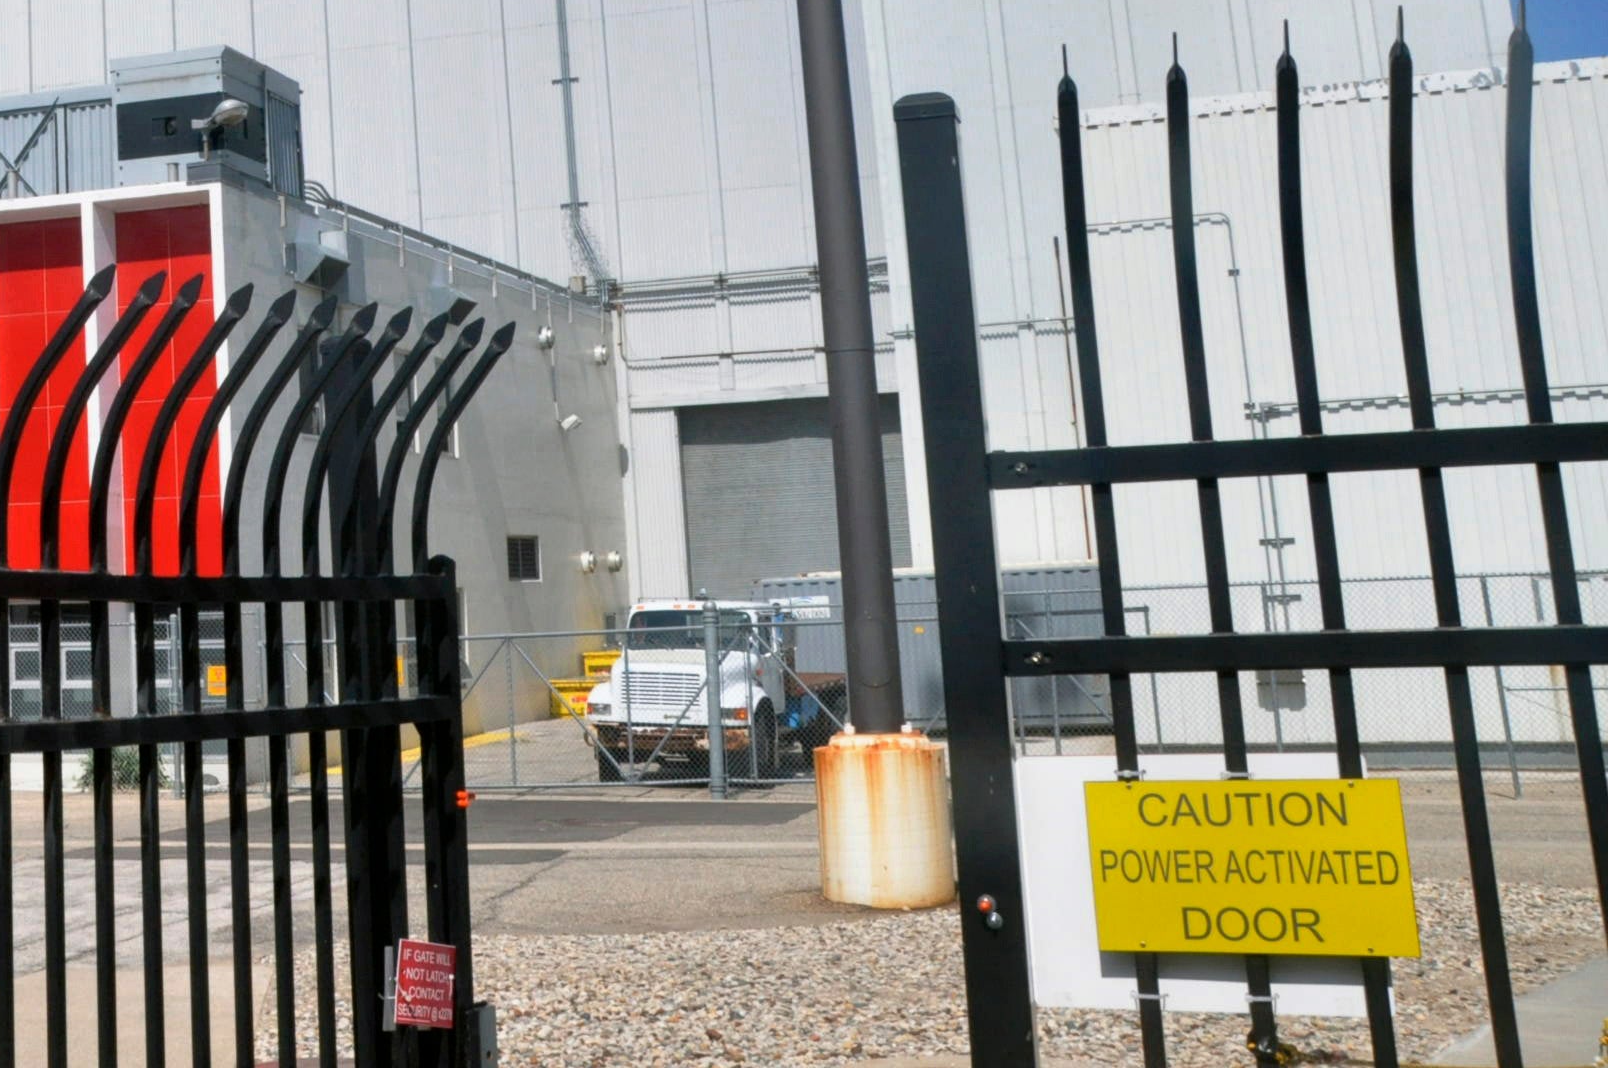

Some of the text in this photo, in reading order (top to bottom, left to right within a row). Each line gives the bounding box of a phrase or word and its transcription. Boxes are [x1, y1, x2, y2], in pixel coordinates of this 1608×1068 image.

[1137, 792, 1349, 827] CAUTION
[1100, 849, 1400, 885] POWER ACTIVATED
[1181, 906, 1325, 943] DOOR
[403, 948, 451, 966] IF GATE WILL
[405, 967, 425, 981] NOT
[408, 986, 445, 1000] CONTACT
[397, 1003, 432, 1020] SECURITY
